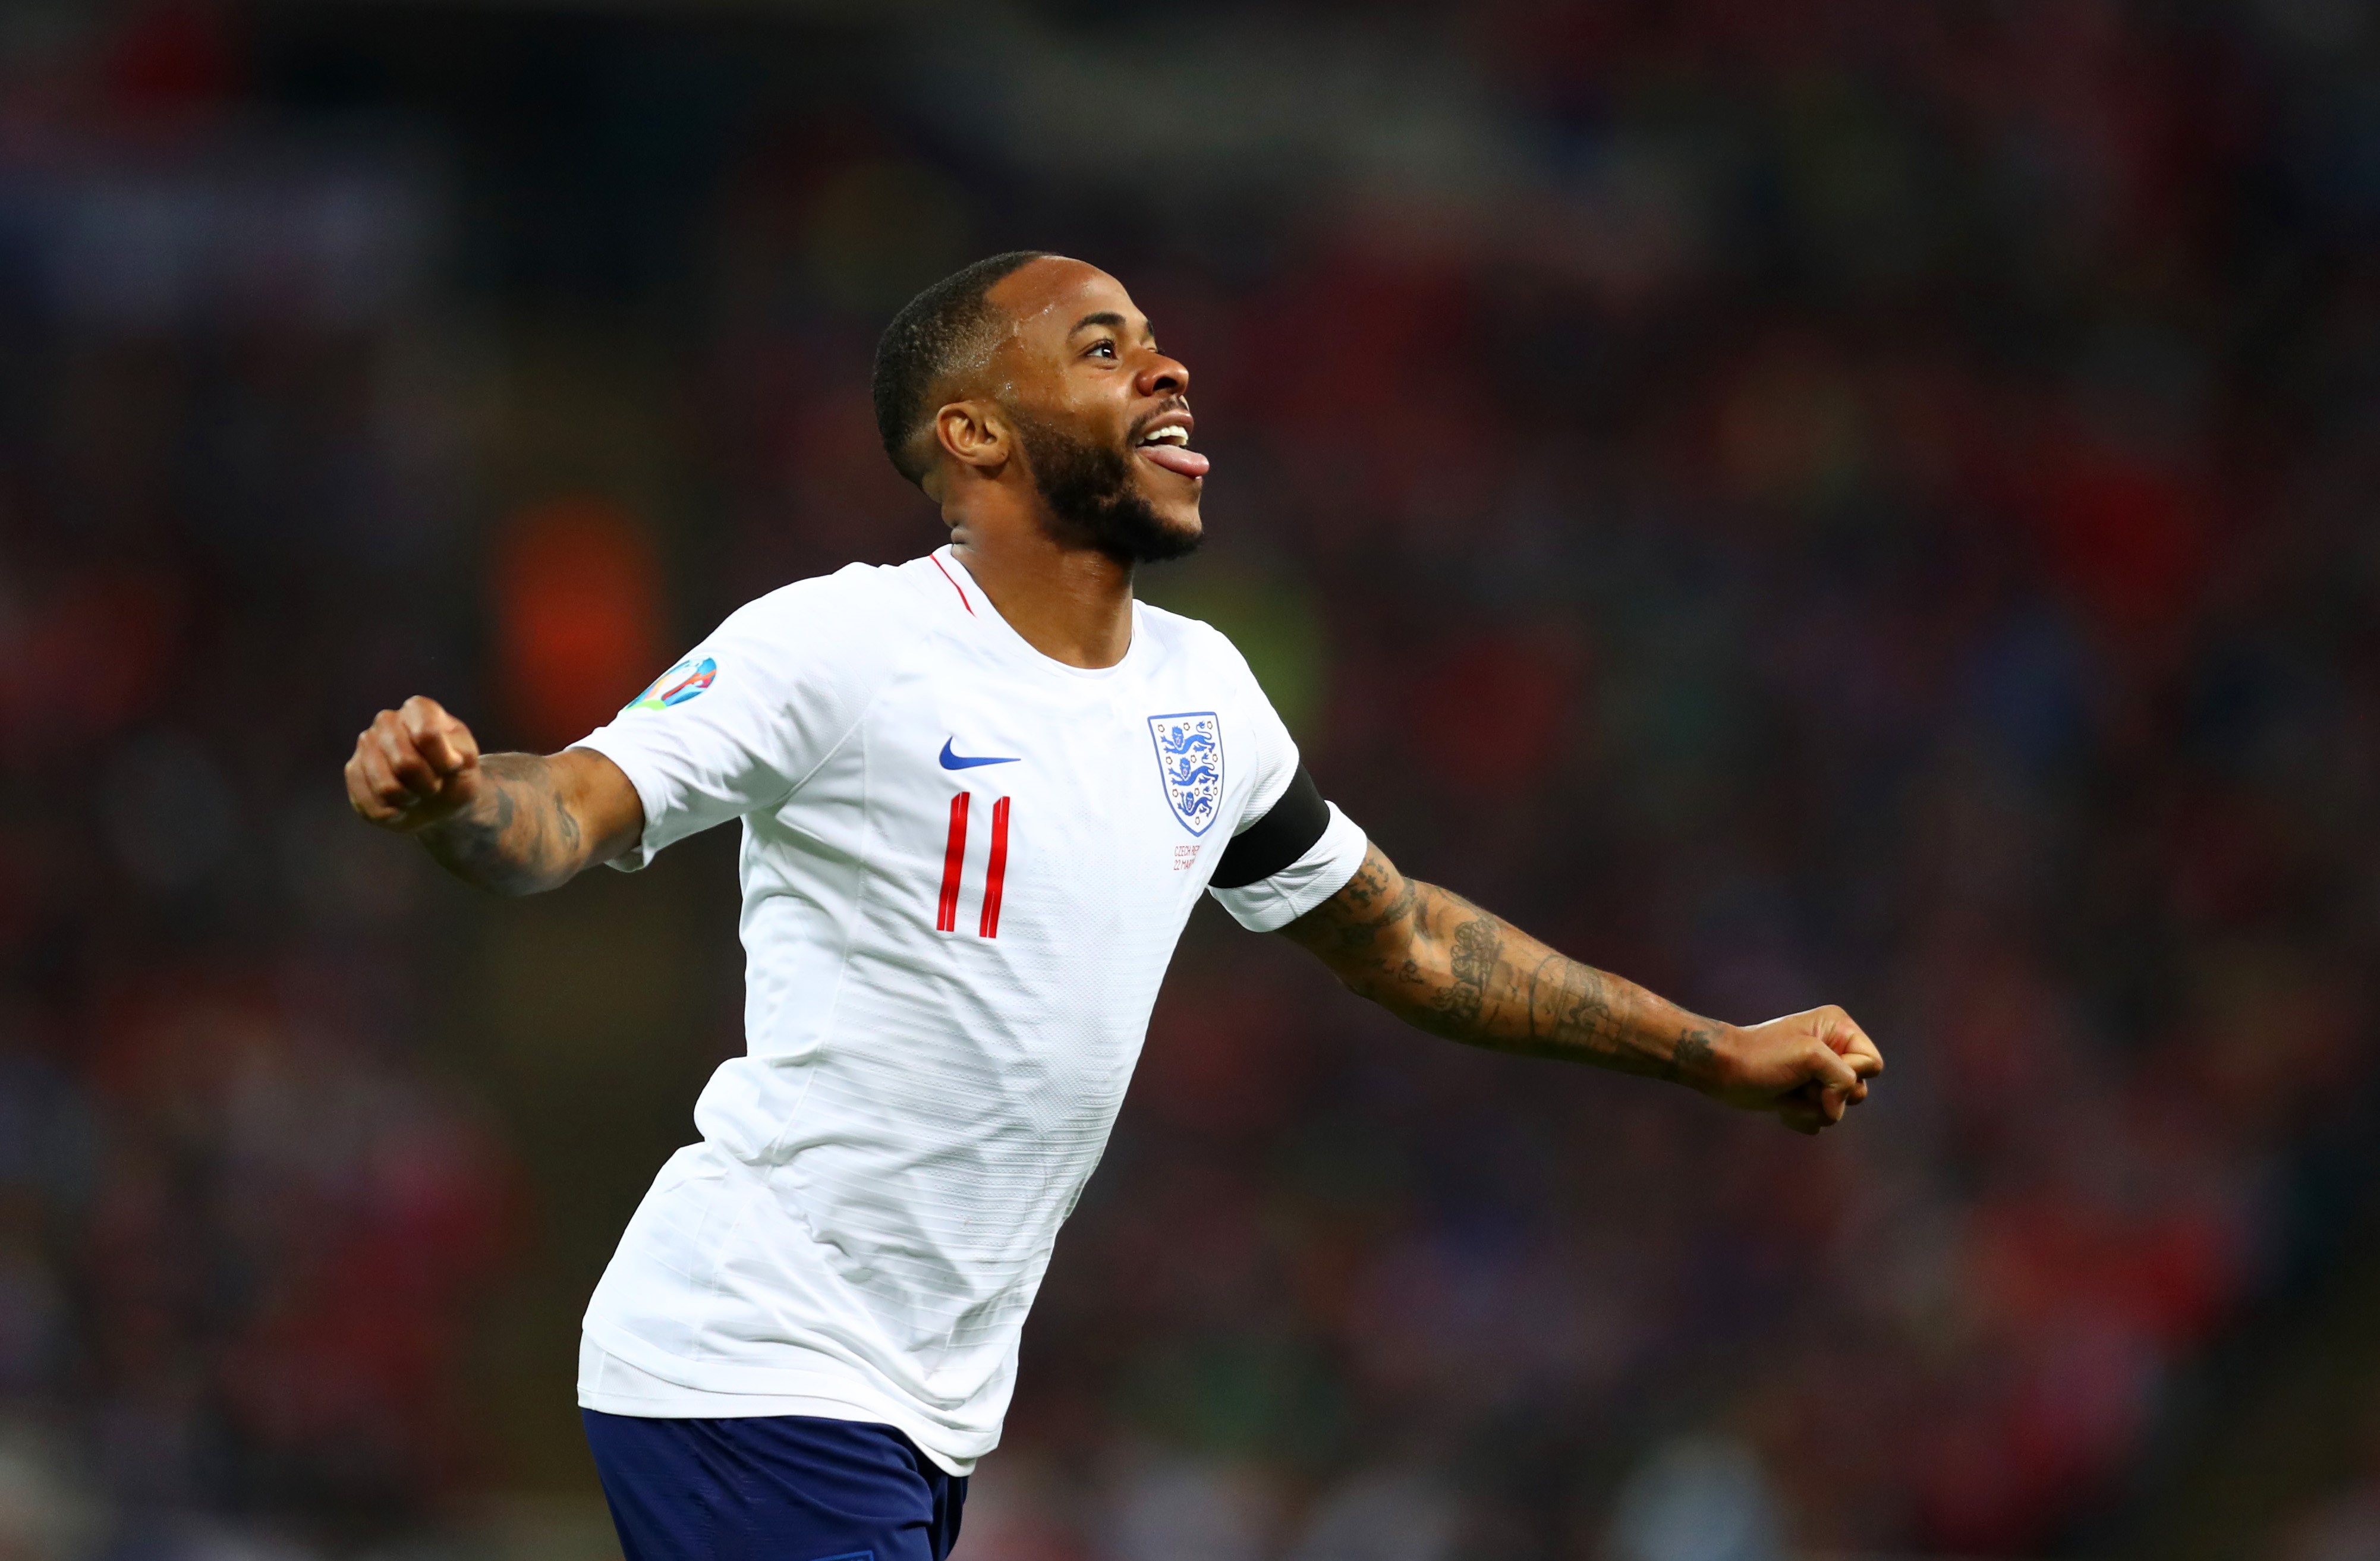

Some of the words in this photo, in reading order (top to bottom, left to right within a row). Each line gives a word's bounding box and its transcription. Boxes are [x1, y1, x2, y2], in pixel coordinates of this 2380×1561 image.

[1175, 845, 1191, 857] CZECH
[936, 792, 1010, 938] 11
[1173, 859, 1180, 870] 22
